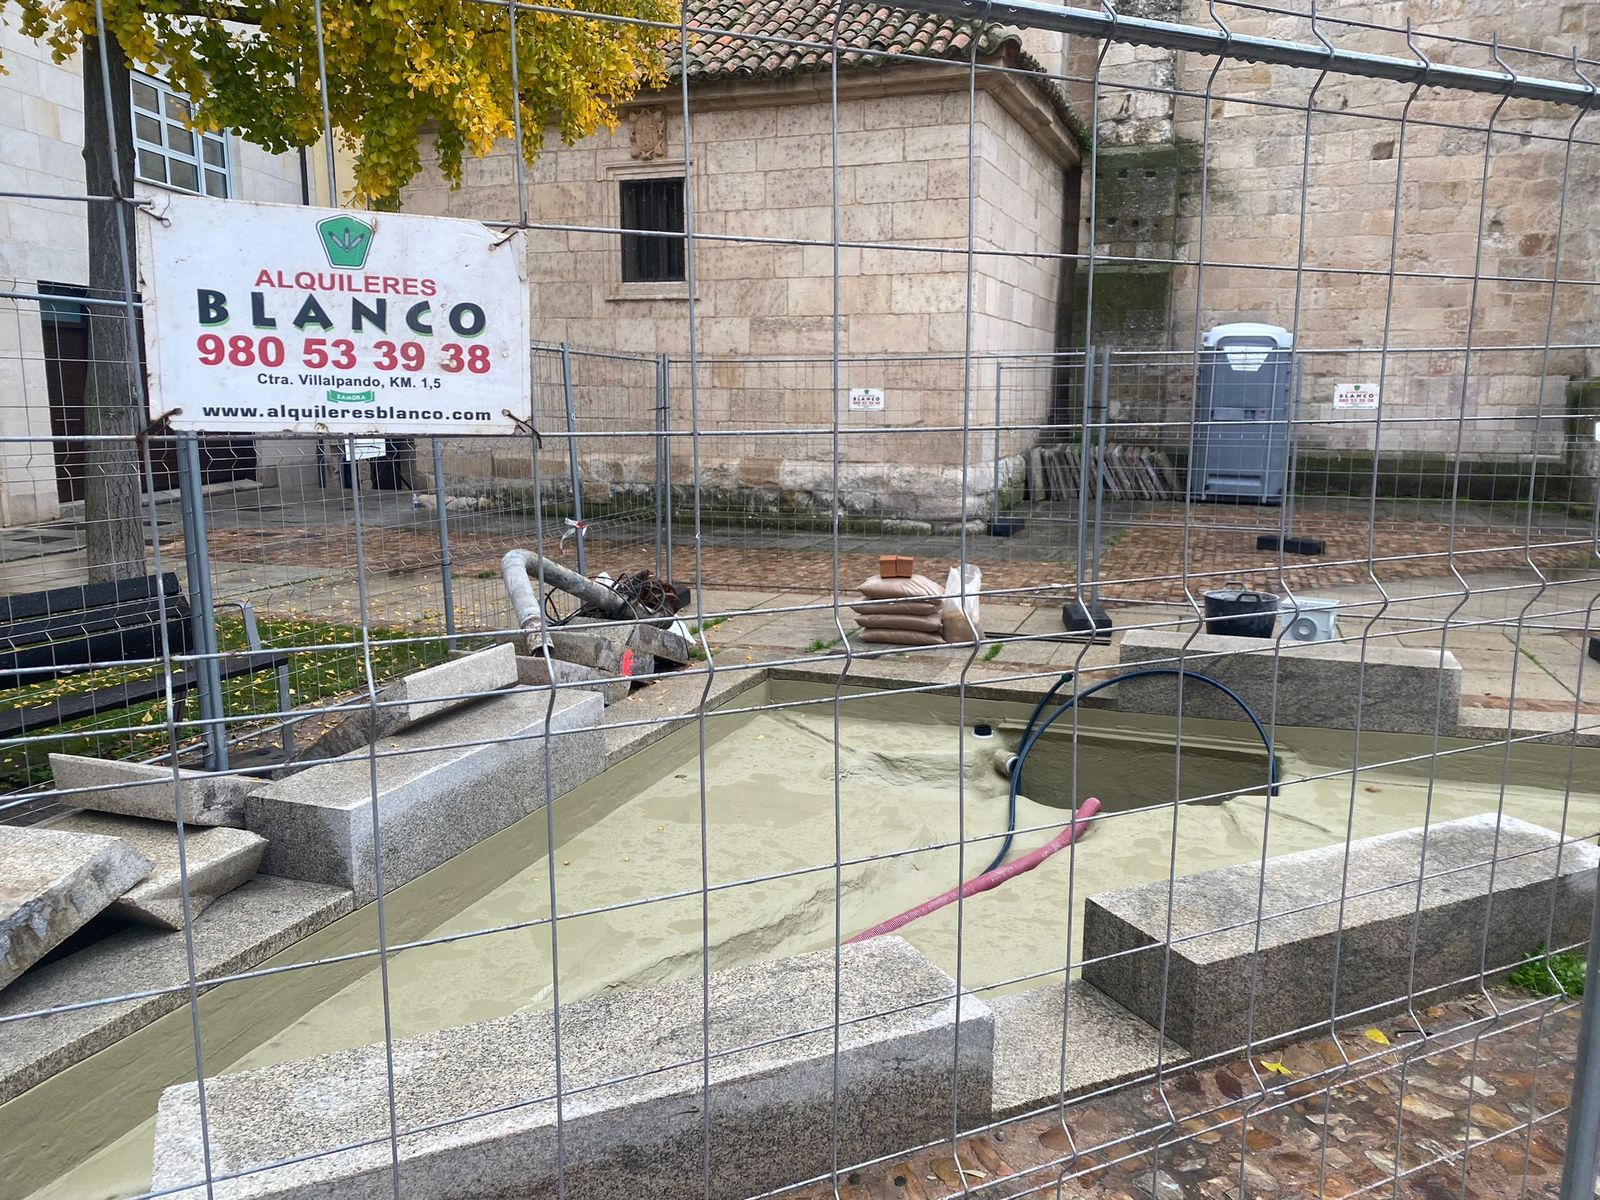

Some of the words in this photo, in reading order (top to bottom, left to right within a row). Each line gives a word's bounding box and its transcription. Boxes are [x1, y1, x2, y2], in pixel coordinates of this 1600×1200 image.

[254, 269, 437, 297] ALQUILERES
[197, 288, 486, 338] BLANCO
[196, 333, 285, 368] 980
[302, 337, 357, 370] 53
[373, 340, 425, 372] 39
[440, 343, 491, 374] 38
[257, 373, 294, 385] Ctra.
[298, 374, 385, 389] Villalpando,
[389, 376, 416, 388] KM.
[421, 378, 441, 390] 1,5
[335, 393, 367, 401] ZAMORA
[202, 404, 491, 421] www.alquileresblanco.com
